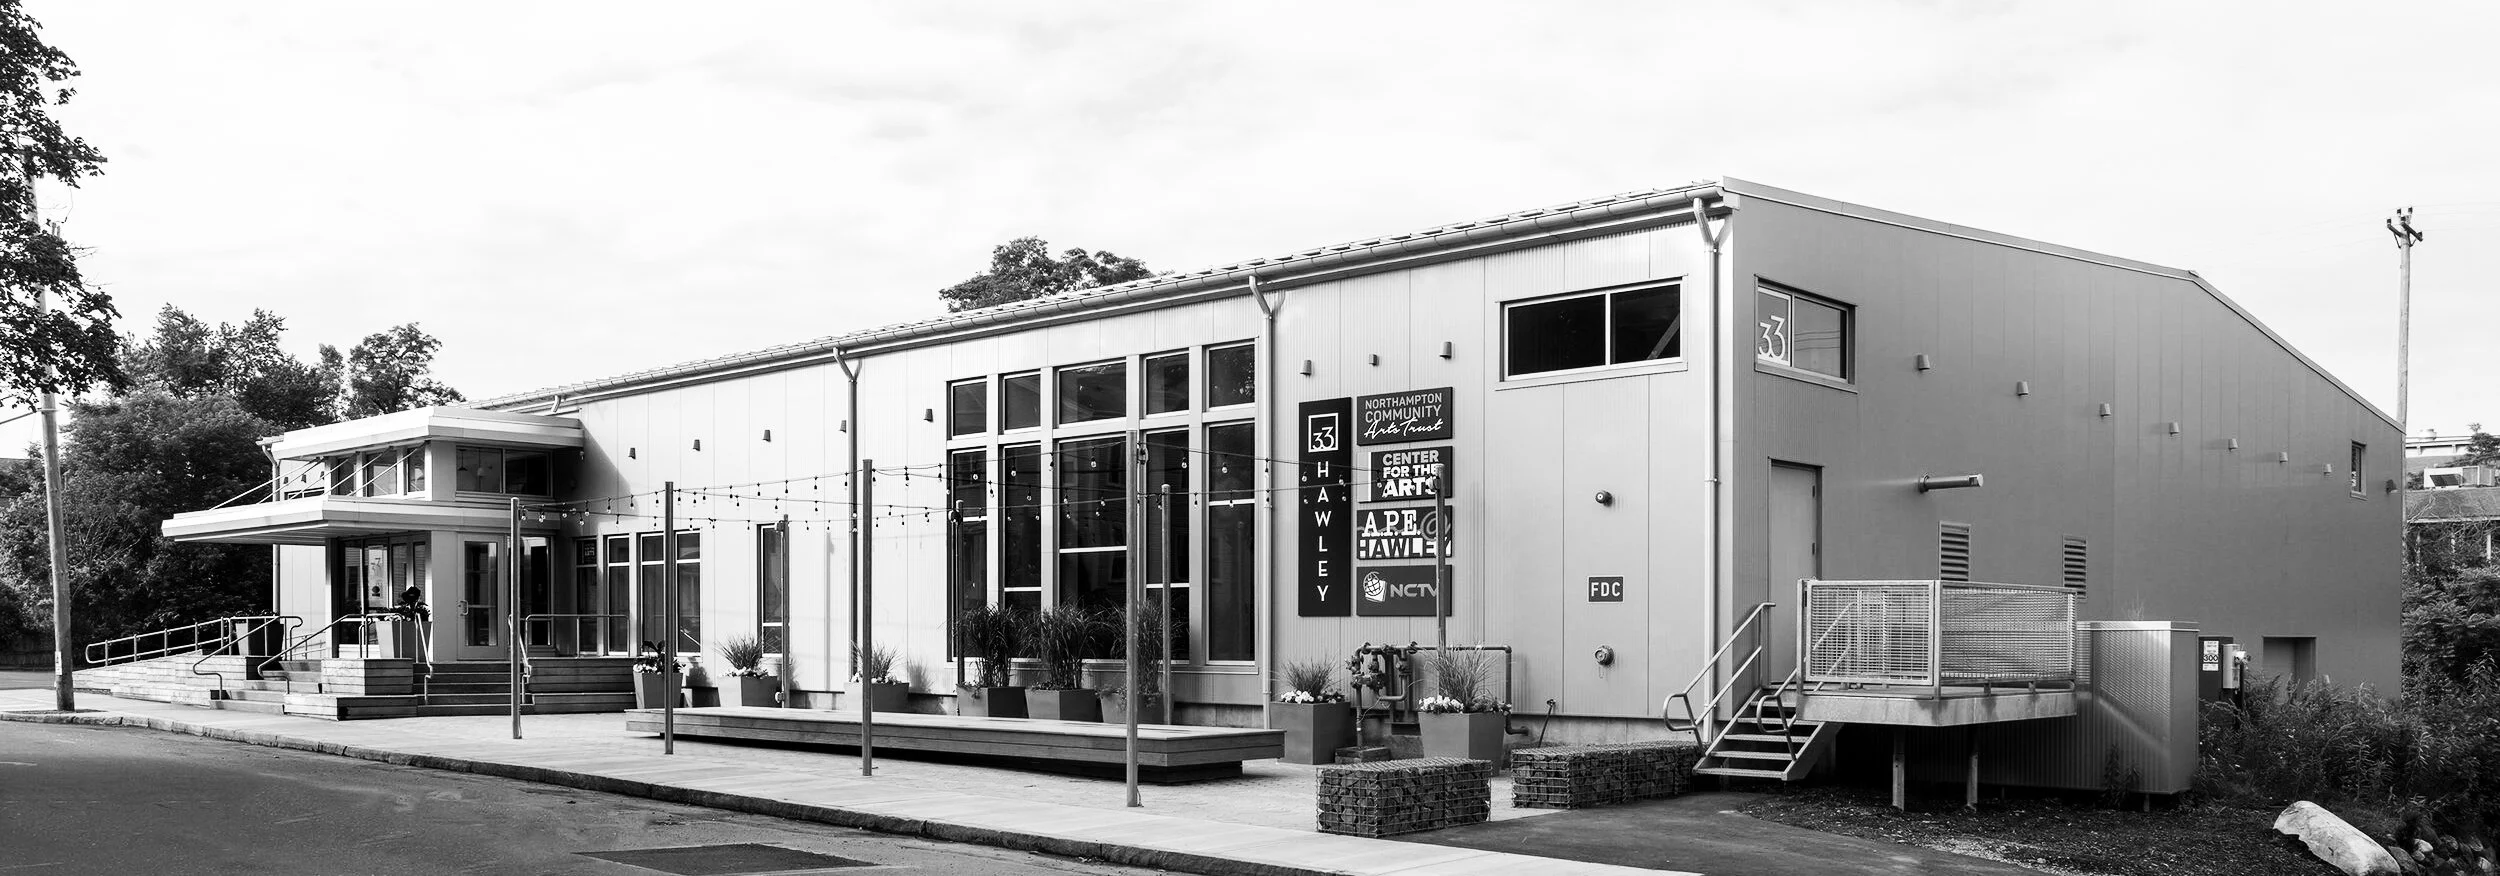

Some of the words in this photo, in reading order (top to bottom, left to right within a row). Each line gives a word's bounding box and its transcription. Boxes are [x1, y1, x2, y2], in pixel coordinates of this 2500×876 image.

[1759, 315, 1786, 360] 33
[1365, 392, 1442, 410] NORTHAMPTON
[1365, 404, 1442, 423] COMMUNITY
[1363, 420, 1401, 439] Arts
[1399, 416, 1443, 436] Trust
[1312, 426, 1335, 450] 33
[1382, 449, 1440, 466] CENTER
[1383, 465, 1410, 479] FOR
[1412, 463, 1439, 477] THE
[1314, 460, 1332, 602] HAWLEY
[1390, 583, 1438, 598] NCTV
[1591, 582, 1621, 597] FDC
